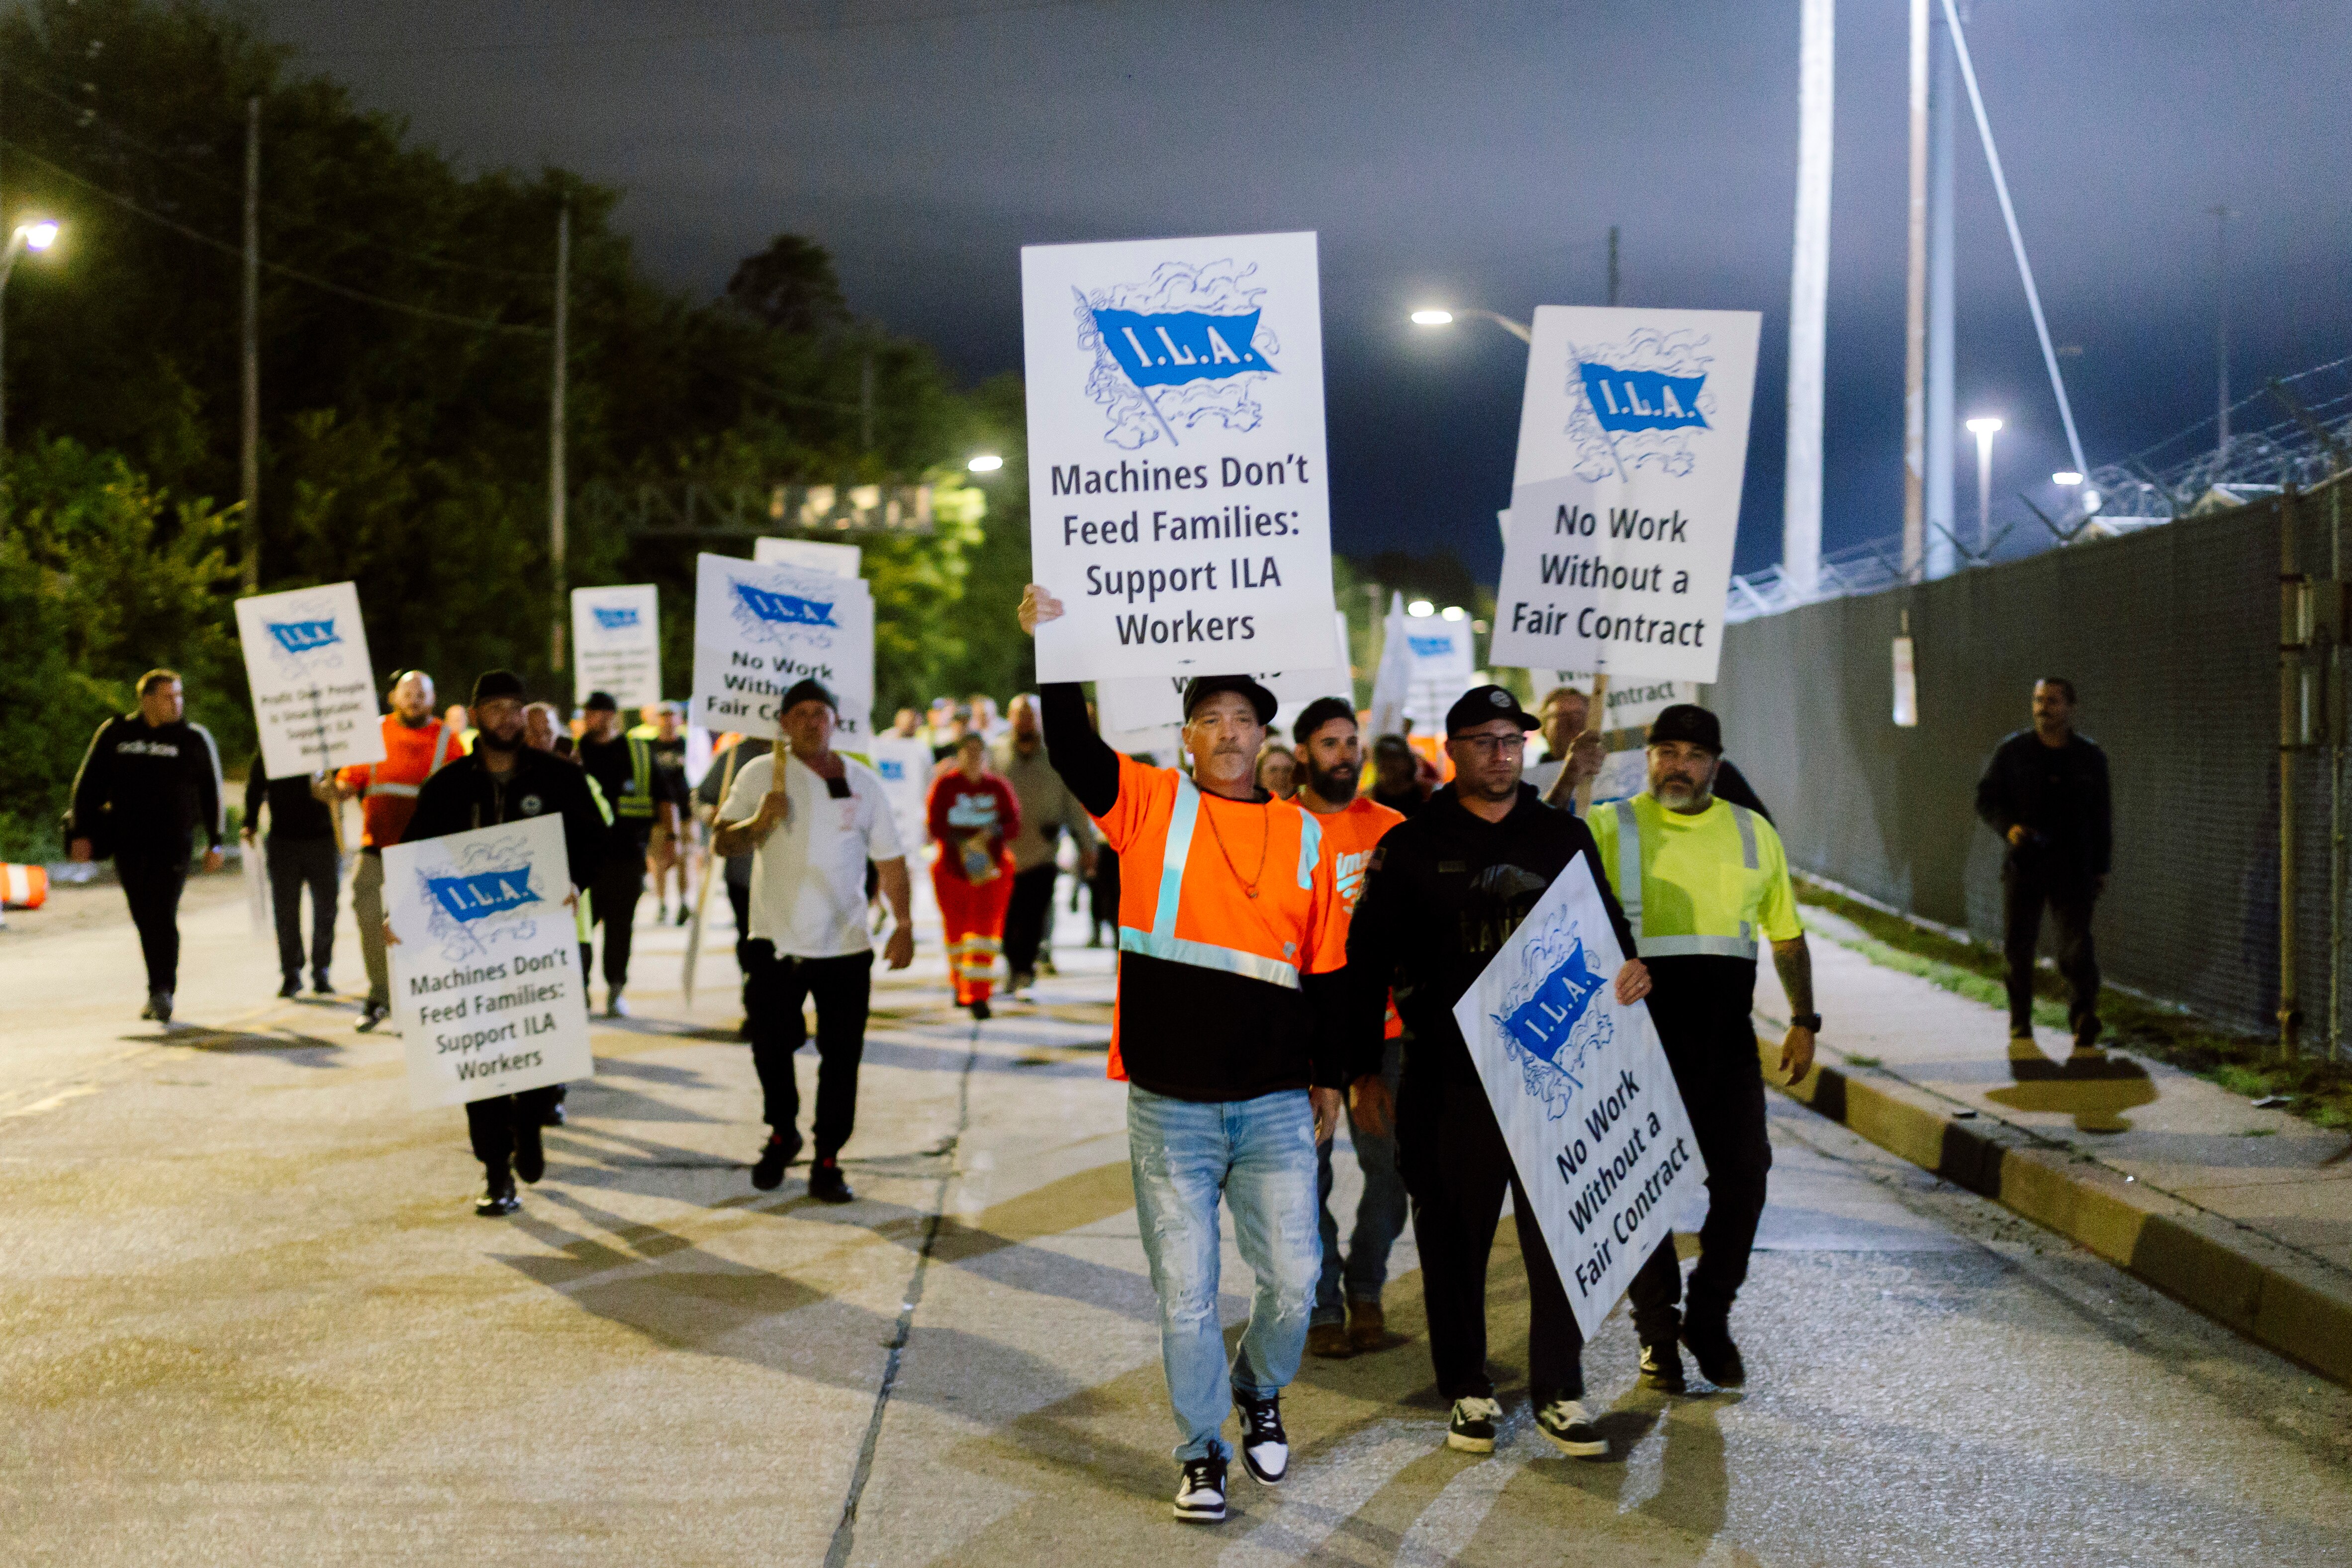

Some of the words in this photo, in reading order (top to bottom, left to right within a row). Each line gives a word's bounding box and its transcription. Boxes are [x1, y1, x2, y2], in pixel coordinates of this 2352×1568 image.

[1122, 326, 1253, 368] I.L.A.
[1599, 379, 1696, 419] I.L.A.
[1051, 460, 1208, 496] Machines
[1222, 455, 1309, 486] Don't
[1064, 510, 1138, 546] Feed
[1153, 506, 1300, 541] Families:
[1555, 503, 1596, 537] No
[1609, 507, 1690, 544] Work
[1087, 559, 1217, 603] Support
[1231, 556, 1281, 588] ILA
[1540, 553, 1662, 592] Without
[1673, 568, 1690, 594] a
[1117, 610, 1256, 645] Workers
[1512, 602, 1569, 637] Fair
[1578, 606, 1705, 647] Contract
[731, 650, 764, 670] No
[772, 656, 833, 679] Work
[706, 695, 751, 717] Fair
[1606, 681, 1675, 708] ontract
[447, 878, 528, 911] I.L.A.
[410, 964, 507, 996] Machines
[513, 948, 568, 976] Don't
[419, 998, 468, 1025] Feed
[475, 981, 565, 1015] Families:
[1524, 975, 1593, 1042] I.L.A.
[436, 1021, 516, 1054] Support
[524, 1012, 557, 1036] ILA
[456, 1048, 543, 1082] Workers
[1556, 1139, 1588, 1186] No
[1585, 1069, 1641, 1137] Work
[1568, 1135, 1648, 1236] Without
[1647, 1111, 1662, 1139] a
[1575, 1236, 1613, 1298] Fair
[1613, 1136, 1690, 1245] Contract
